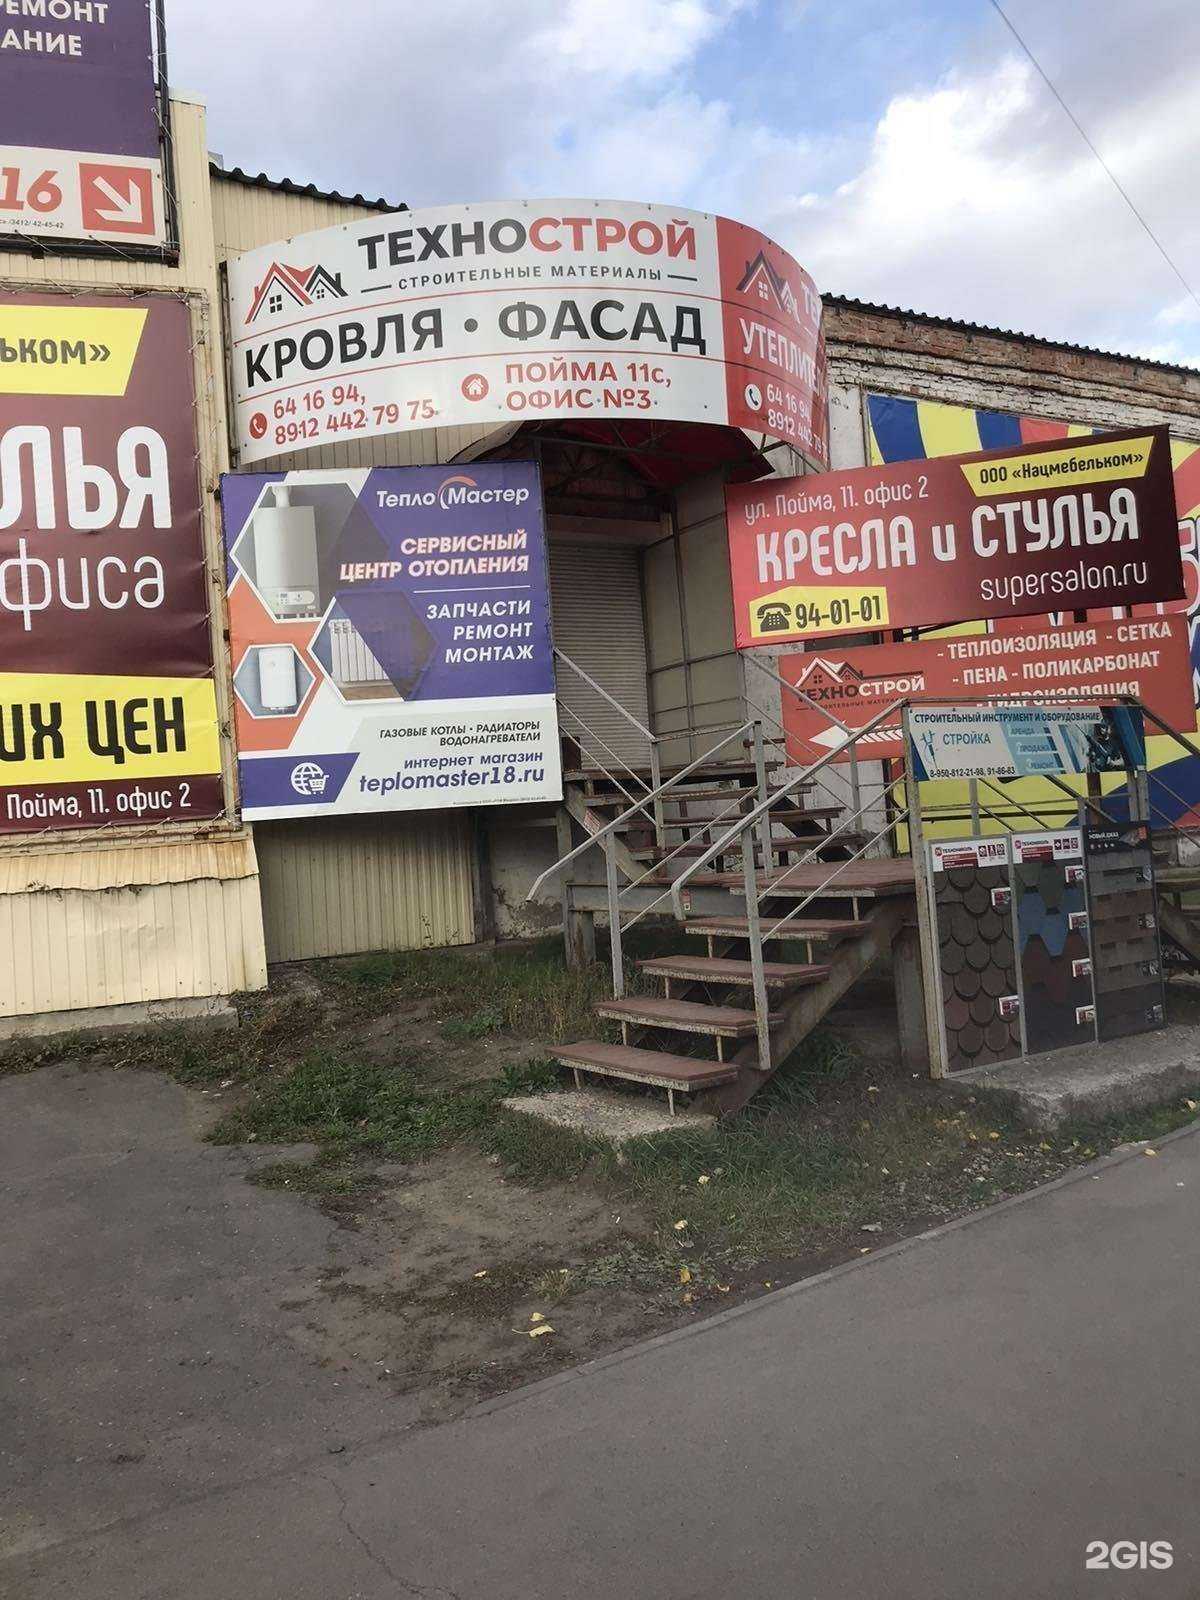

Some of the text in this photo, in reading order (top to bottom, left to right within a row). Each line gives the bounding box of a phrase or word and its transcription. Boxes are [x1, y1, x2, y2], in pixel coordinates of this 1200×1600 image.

[0, 0, 108, 23] ЕМОНТ
[1, 29, 82, 56] АНИЕ
[0, 168, 62, 212] 16
[358, 217, 697, 270] ТЕХНОСТРОЙ
[398, 265, 661, 290] СТРОИТЕЛЬНЫЕ МАТЕРИАЛЫ
[245, 299, 706, 388] КРОВЛЯ ФАСАД
[505, 356, 618, 384] ПОЙМА
[273, 383, 365, 420] 64 16 94,
[505, 388, 651, 411] ОФИС №3
[766, 383, 782, 406] 64
[786, 392, 797, 413] 16
[275, 398, 435, 445] 8912 442 79 75
[768, 408, 795, 437] 8912
[0, 425, 172, 530] ЛЬЯ
[979, 452, 1144, 485] ООО «Нацмебельком»
[376, 486, 530, 509] Тепло Мастер
[745, 474, 929, 527] ул. Пойма, 11. офис 2
[400, 529, 528, 555] СЕРВИСНЫЙ
[756, 487, 1139, 585] КРЕСЛА и СТУЛЬЯ
[340, 555, 529, 582] ЦЕНТР ОТОПЛЕНИЯ
[980, 560, 1147, 605] supersalon.ru
[0, 538, 165, 631] фиса
[427, 600, 531, 620] ЗАПЧАСТИ
[796, 594, 881, 629] 94-01-01
[453, 622, 533, 641] РЕМОНТ
[947, 621, 1172, 660] ТЕПЛОИЗОЛЯЦИЯ СЕТКА
[445, 645, 534, 664] МОНТАЖ
[963, 650, 1160, 686] ПЕНА ПОЛИКАРБОНАТ
[85, 697, 186, 765] ЦЕН
[380, 721, 540, 739] ГАЗОВЫЕ КОТЛЫ РАДИАТОРЫ
[914, 711, 1100, 724] СТРОИТЕЛЬНЫЙ ИНСТРУМЕНТ И ОБОРУДОВАНИЕ
[440, 732, 541, 747] ВОДОНАГРЕВАТЕЛИ
[942, 731, 991, 745] СТРОЙКА
[404, 752, 543, 770] интернет магазин
[359, 766, 545, 796] teplomaster18.ru
[7, 782, 191, 820] Пойма, 11. офис 2
